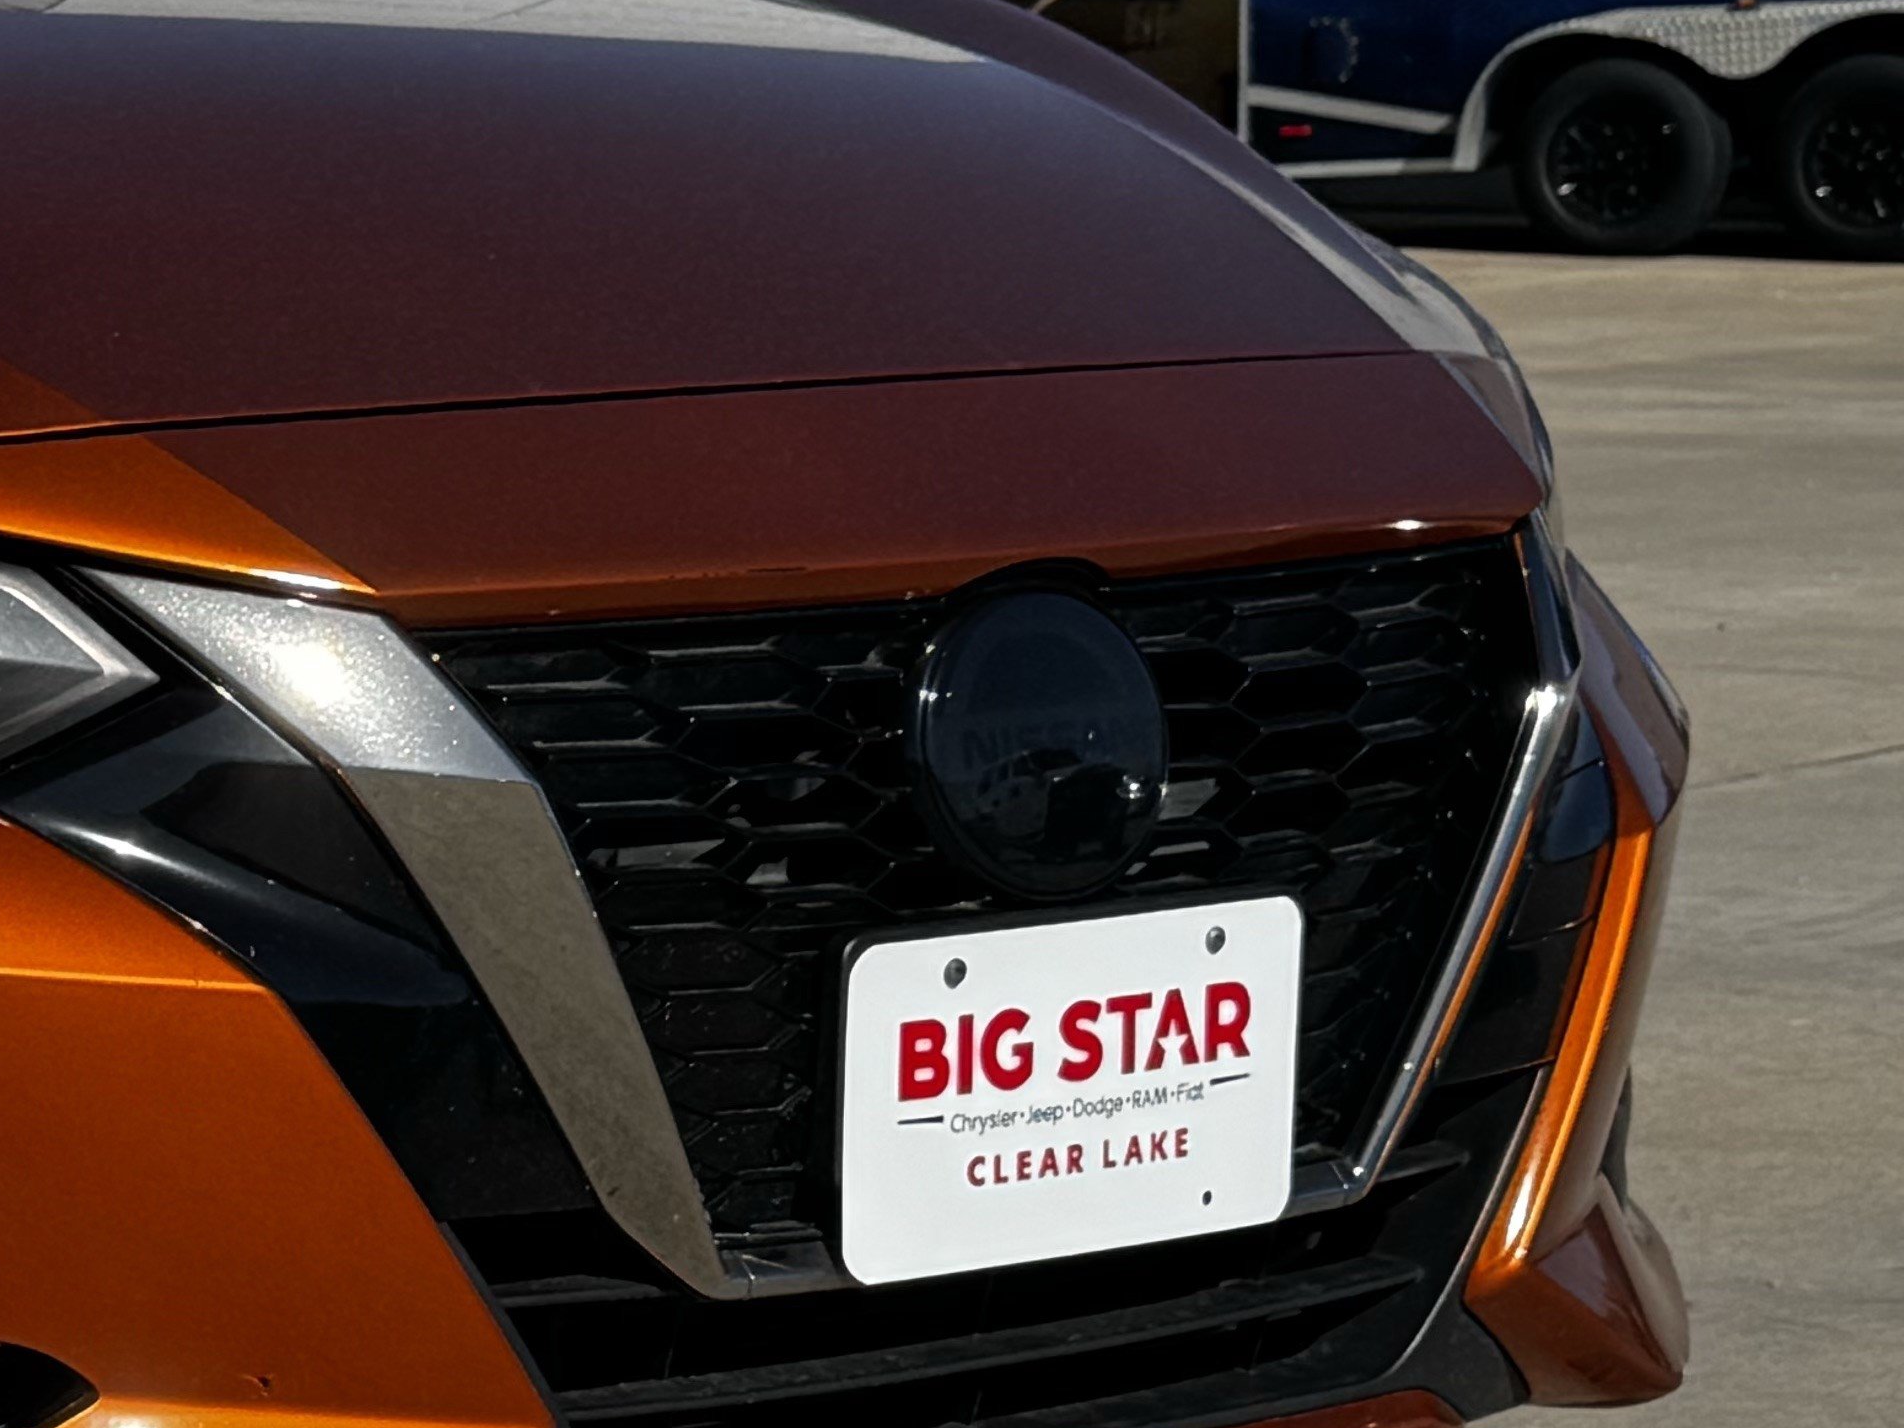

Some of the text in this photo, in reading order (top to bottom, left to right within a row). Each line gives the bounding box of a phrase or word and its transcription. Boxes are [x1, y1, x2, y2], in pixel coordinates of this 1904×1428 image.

[898, 981, 1251, 1102] BIG STAR
[950, 1110, 1017, 1135] Chrysler
[1026, 1104, 1063, 1126] Jeep
[1072, 1097, 1123, 1119] Dodge
[1131, 1087, 1168, 1109] RAM
[967, 1128, 1188, 1187] CLEAR LAKE
